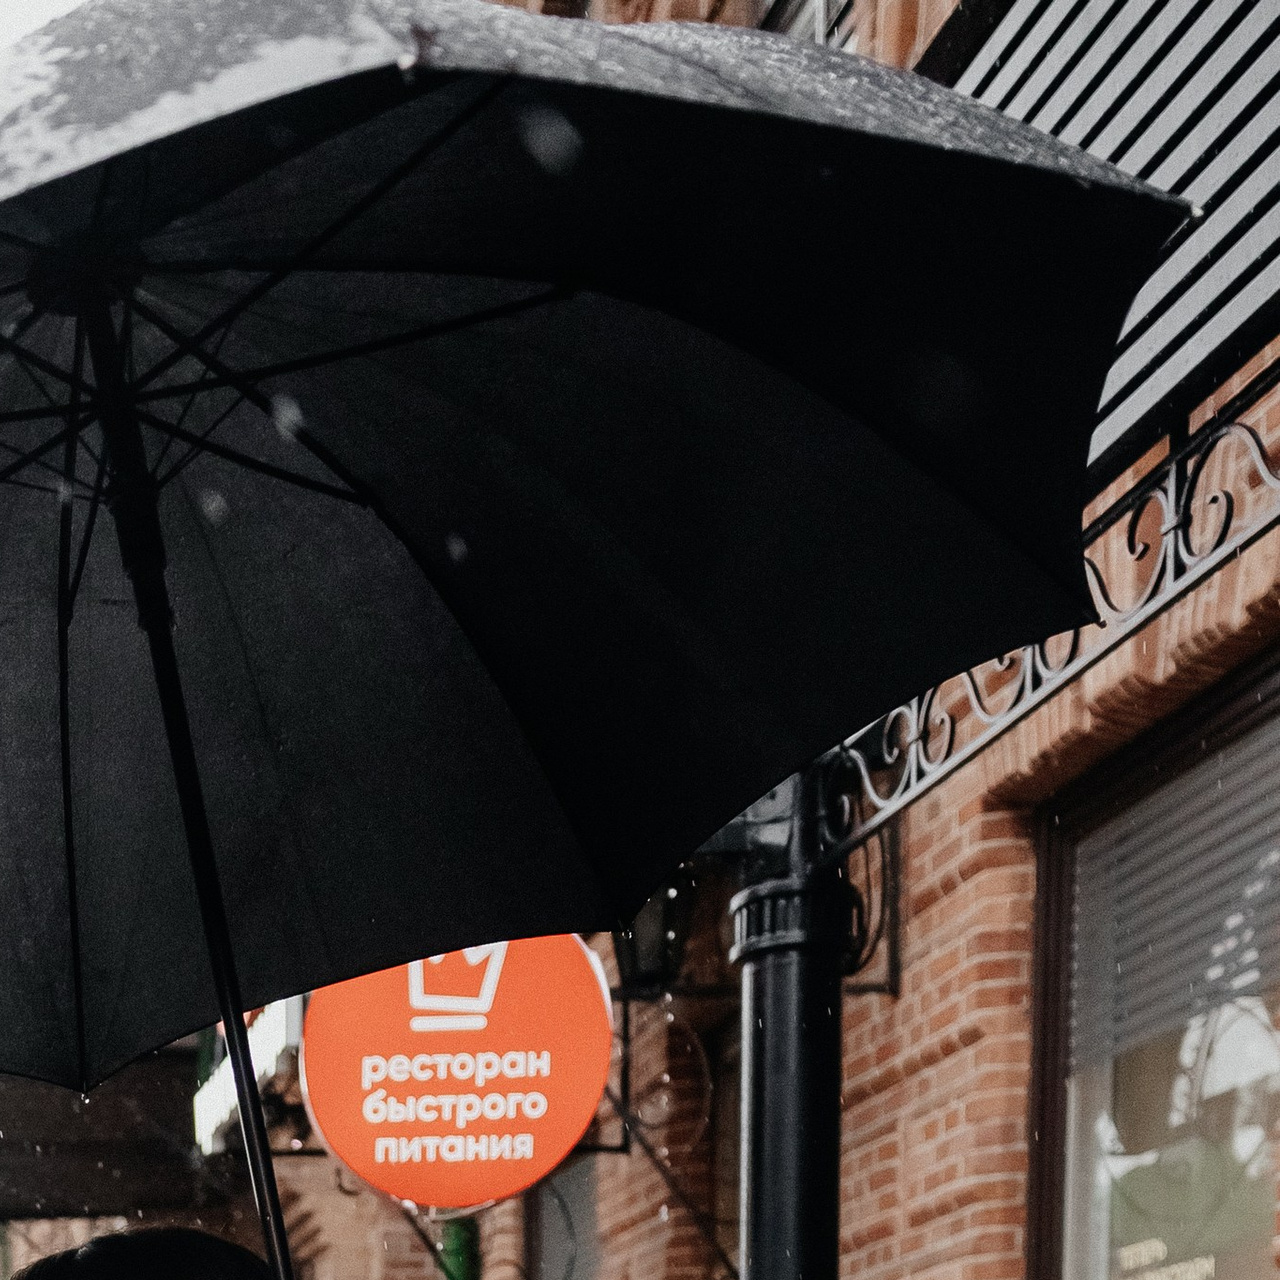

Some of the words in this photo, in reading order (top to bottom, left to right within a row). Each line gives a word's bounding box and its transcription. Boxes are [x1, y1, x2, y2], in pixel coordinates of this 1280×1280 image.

[361, 1051, 551, 1090] ресторан
[362, 1088, 548, 1129] быстрого
[375, 1133, 534, 1164] питания
